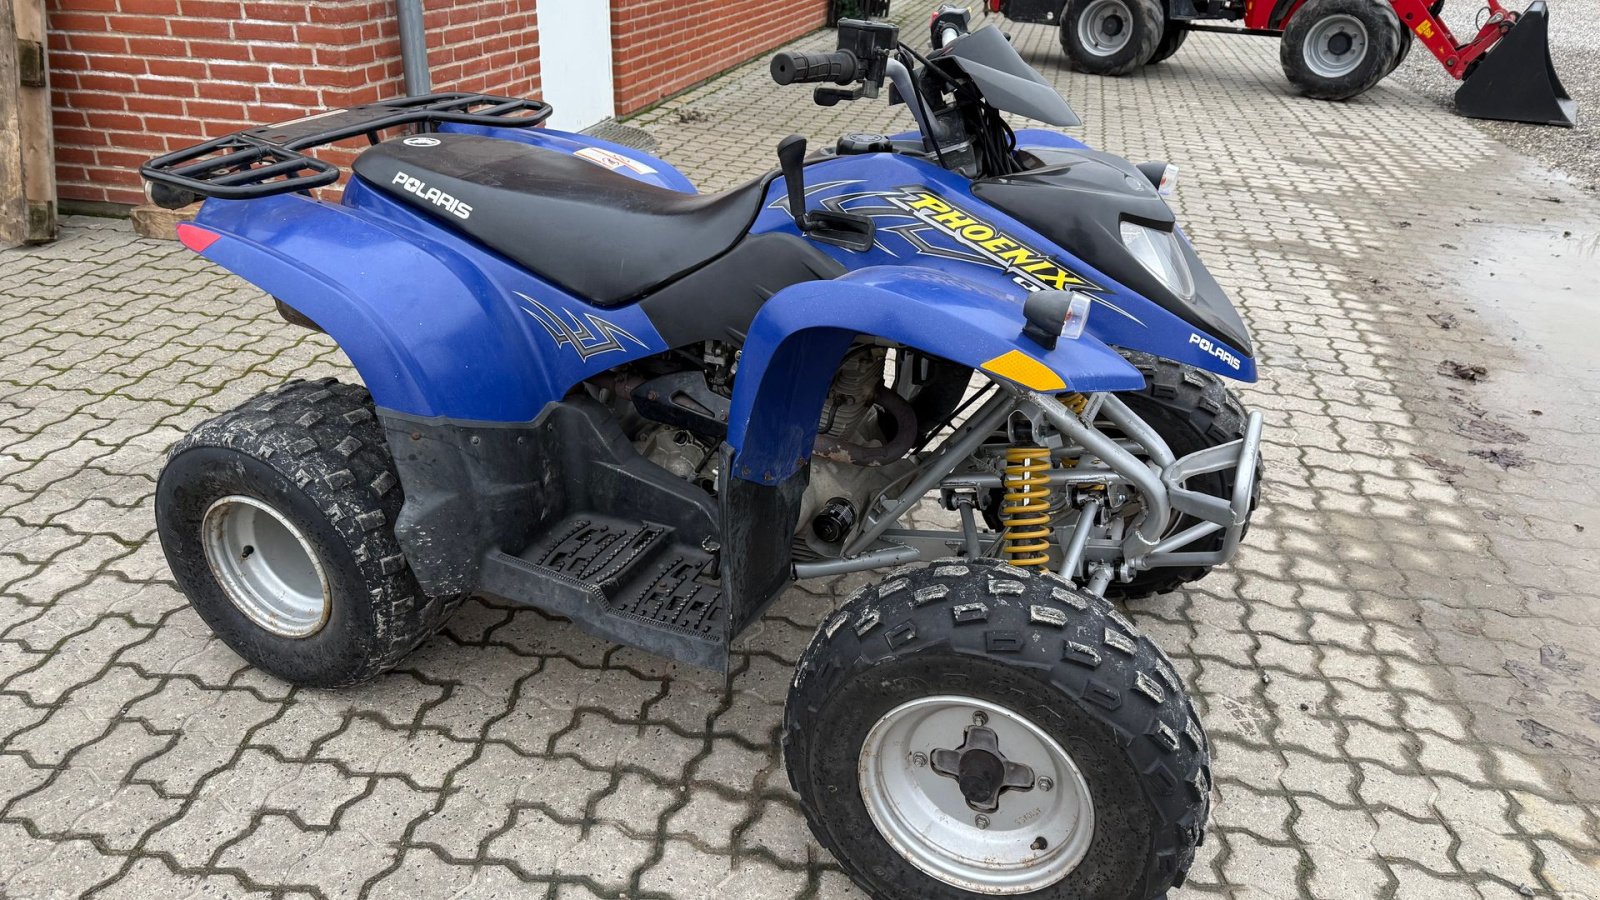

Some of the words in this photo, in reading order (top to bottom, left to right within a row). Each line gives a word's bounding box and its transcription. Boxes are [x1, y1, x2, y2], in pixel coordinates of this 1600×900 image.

[392, 171, 473, 219] POLARIS
[911, 193, 1086, 290] PHOENIX
[1189, 333, 1241, 370] POLARIS
